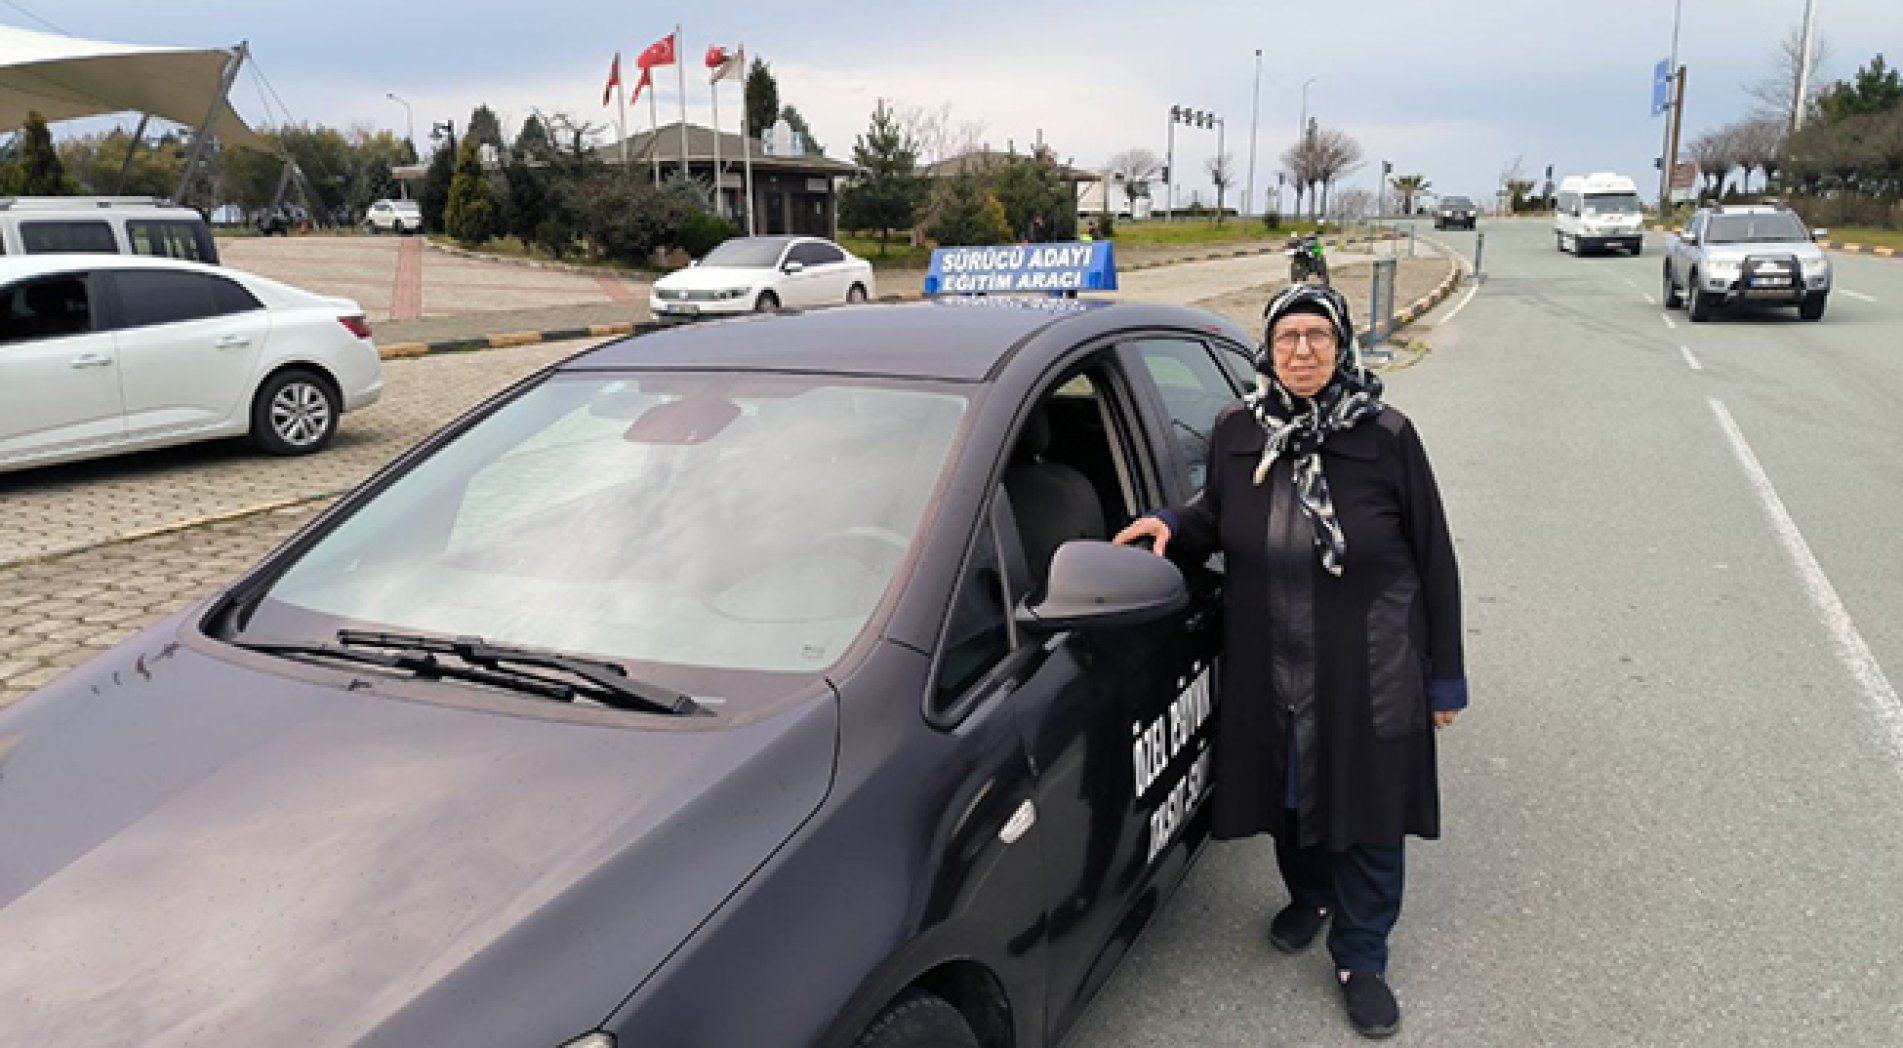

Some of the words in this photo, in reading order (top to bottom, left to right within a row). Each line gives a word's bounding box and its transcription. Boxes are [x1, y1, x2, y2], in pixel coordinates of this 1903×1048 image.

[942, 247, 1025, 272] SÜRÜCÜ
[1028, 246, 1093, 269] ADAYI
[943, 272, 1012, 291] EĞİTİM
[1017, 271, 1082, 288] ARACI
[1133, 714, 1168, 797] ÖZEL
